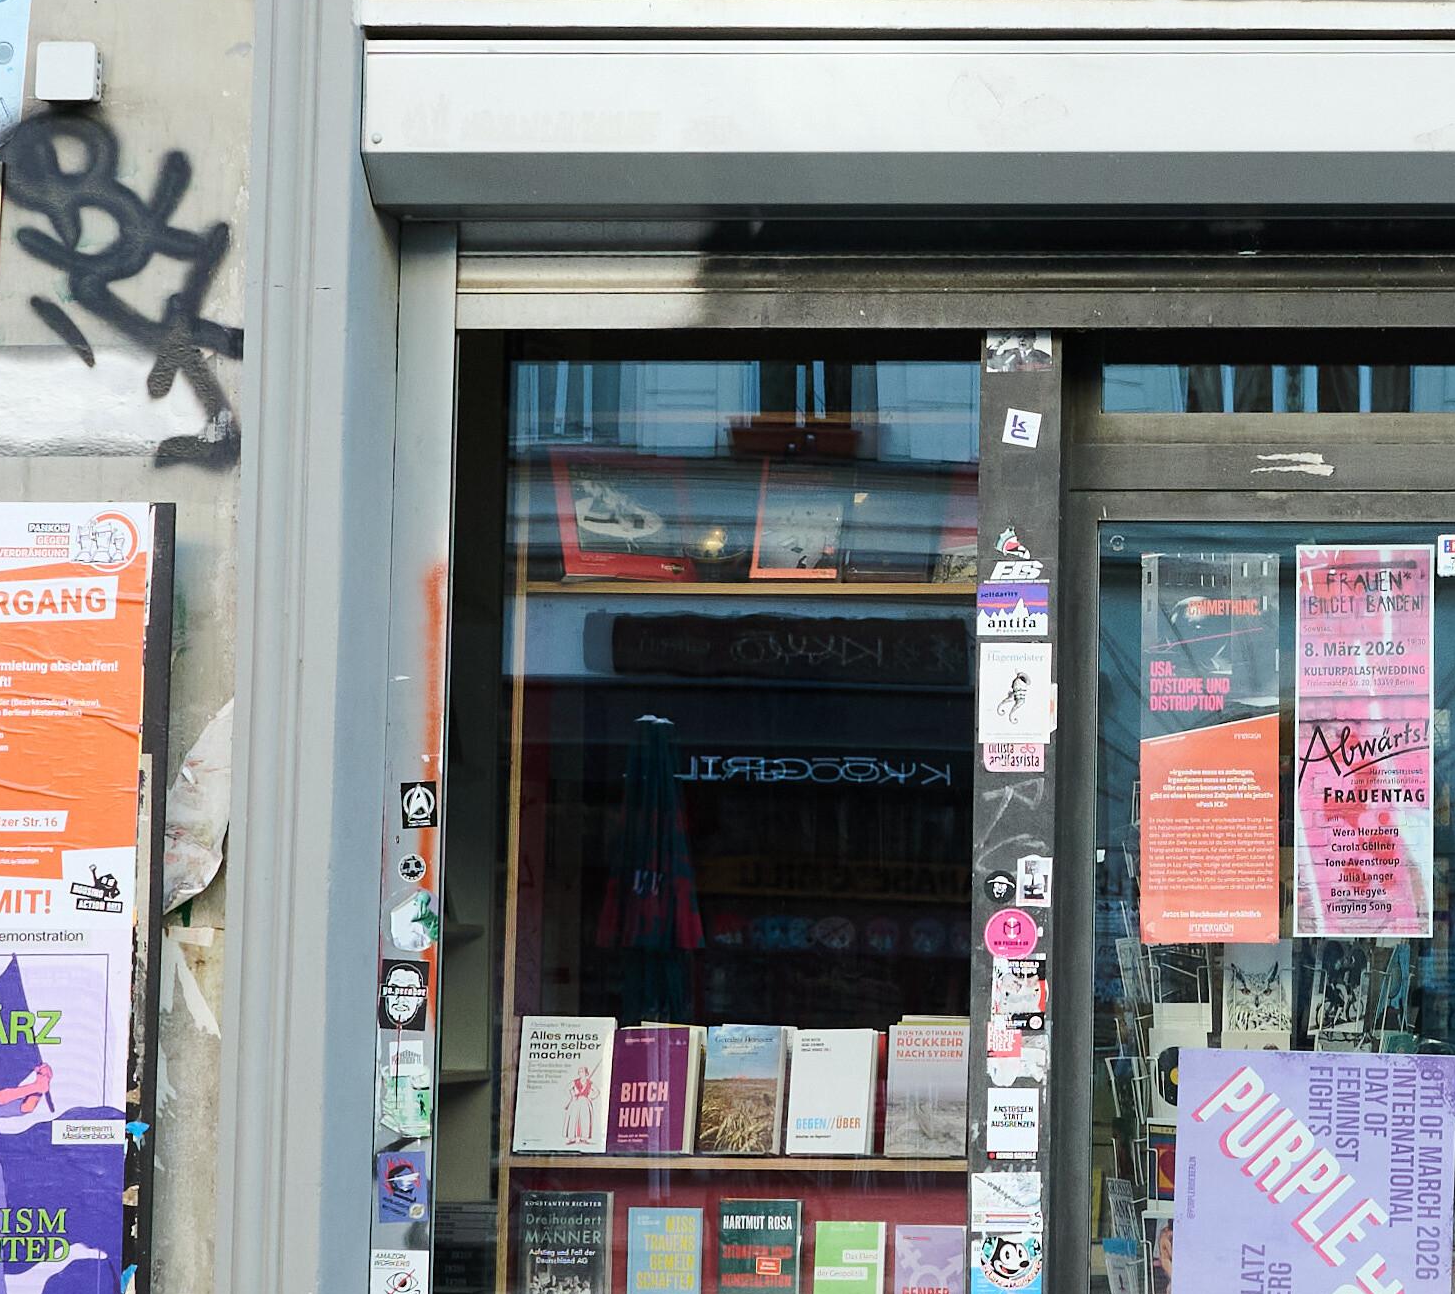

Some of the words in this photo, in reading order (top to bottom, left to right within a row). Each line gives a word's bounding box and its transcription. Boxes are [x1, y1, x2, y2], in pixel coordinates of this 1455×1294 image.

[987, 616, 1037, 628] antifa
[50, 659, 118, 672] abschaffen!
[1150, 661, 1176, 677] USA:
[1150, 678, 1204, 694] DYSTOPIE
[1207, 678, 1230, 694] UND
[1150, 695, 1224, 712] DISTRUPTION
[1323, 787, 1425, 804] FRAUENTAG
[22, 816, 43, 828] Str.
[45, 816, 58, 828] 16
[529, 1042, 556, 1051] man
[559, 1042, 601, 1051] selber
[530, 1032, 559, 1041] Alles
[565, 1032, 599, 1041] muss
[529, 1051, 581, 1060] machen
[620, 1081, 668, 1103] BITCH
[1364, 1067, 1389, 1106] DAY
[1420, 1069, 1444, 1108] 8TH
[1308, 1066, 1333, 1137] FIGHTS
[618, 1107, 664, 1128] HUNT
[1335, 1067, 1361, 1162] FEMINIST
[1363, 1113, 1387, 1137] OF
[1420, 1115, 1443, 1140] OF
[1389, 1068, 1416, 1227] INTERNATIONAL
[1192, 1065, 1390, 1266] PURPLE
[1417, 1146, 1442, 1219] MARCH
[722, 1215, 765, 1231] HARTMUT
[768, 1216, 793, 1231] ROSA
[1416, 1226, 1440, 1280] 2026
